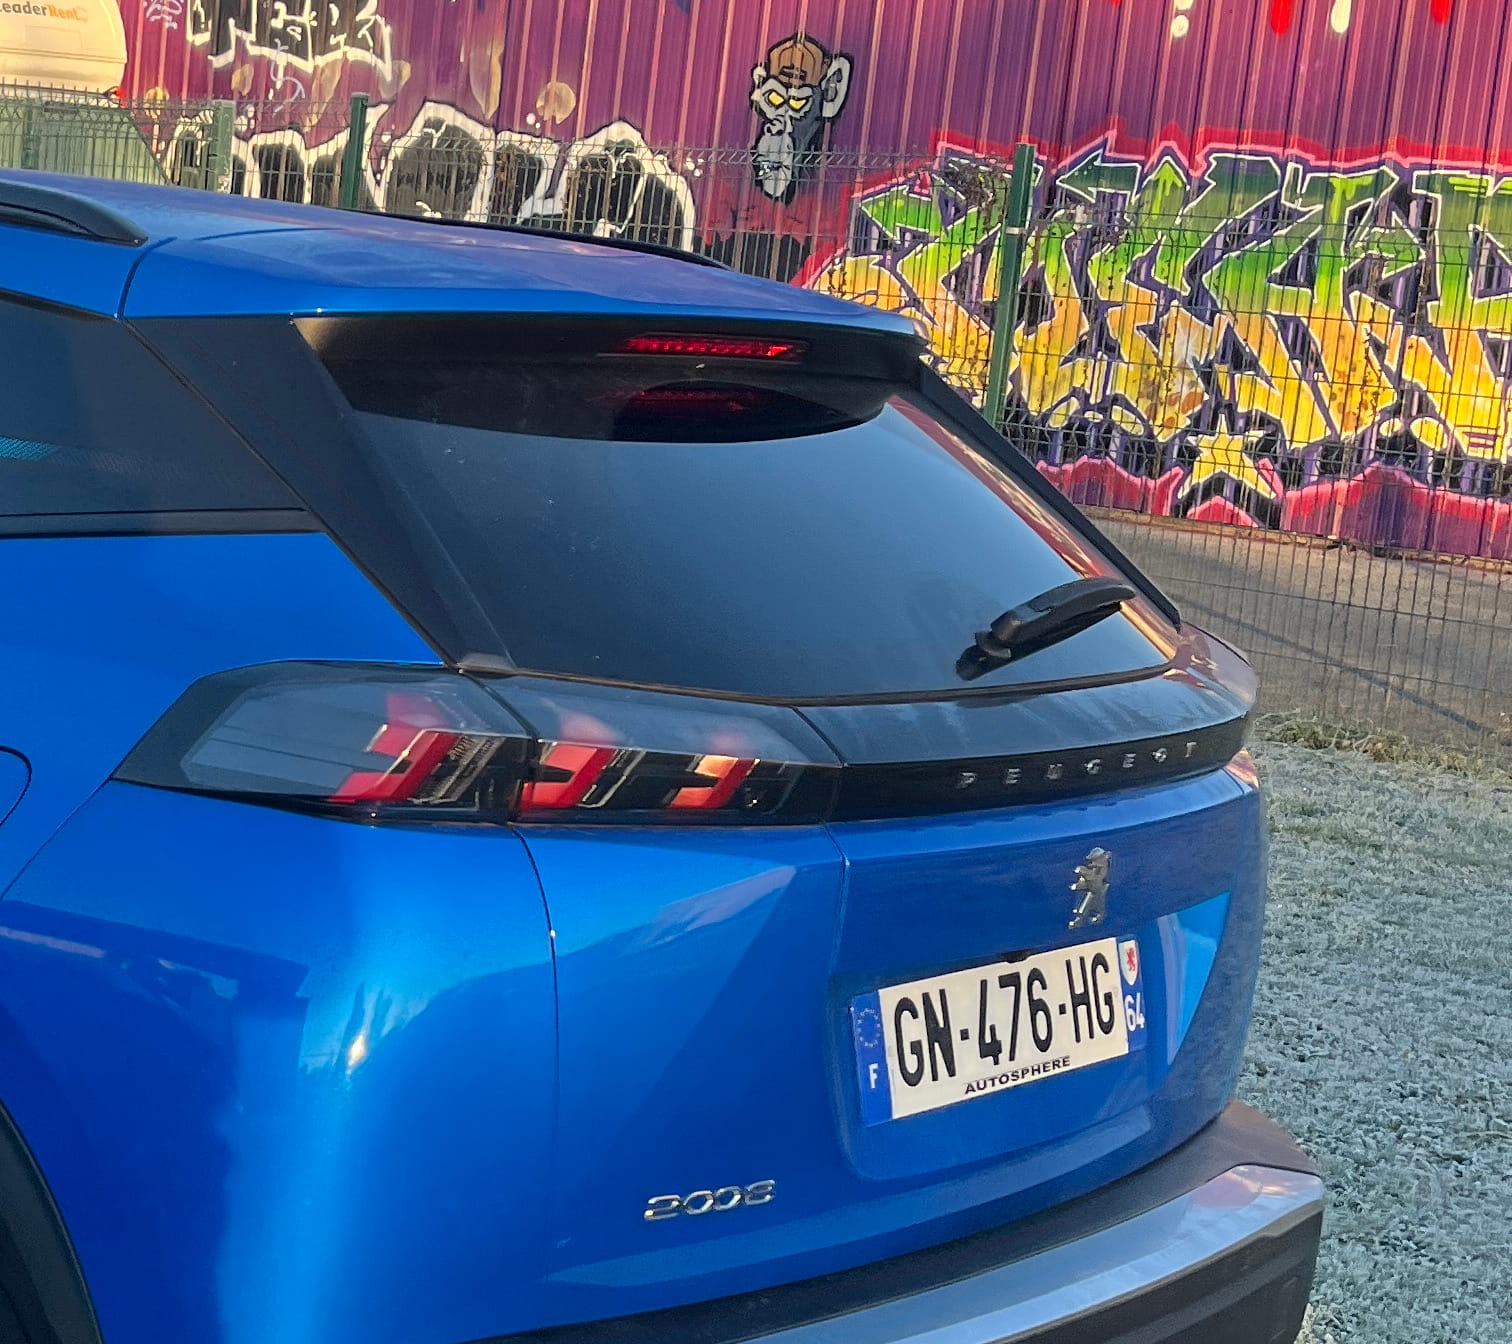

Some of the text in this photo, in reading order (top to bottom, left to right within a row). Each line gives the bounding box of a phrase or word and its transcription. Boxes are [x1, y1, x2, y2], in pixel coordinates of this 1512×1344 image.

[956, 741, 1197, 789] PEUGEOT
[869, 952, 1145, 1089] F GN-476-HG 64
[965, 1055, 1071, 1096] AUTOSPHERE
[643, 1179, 776, 1222] 2008
